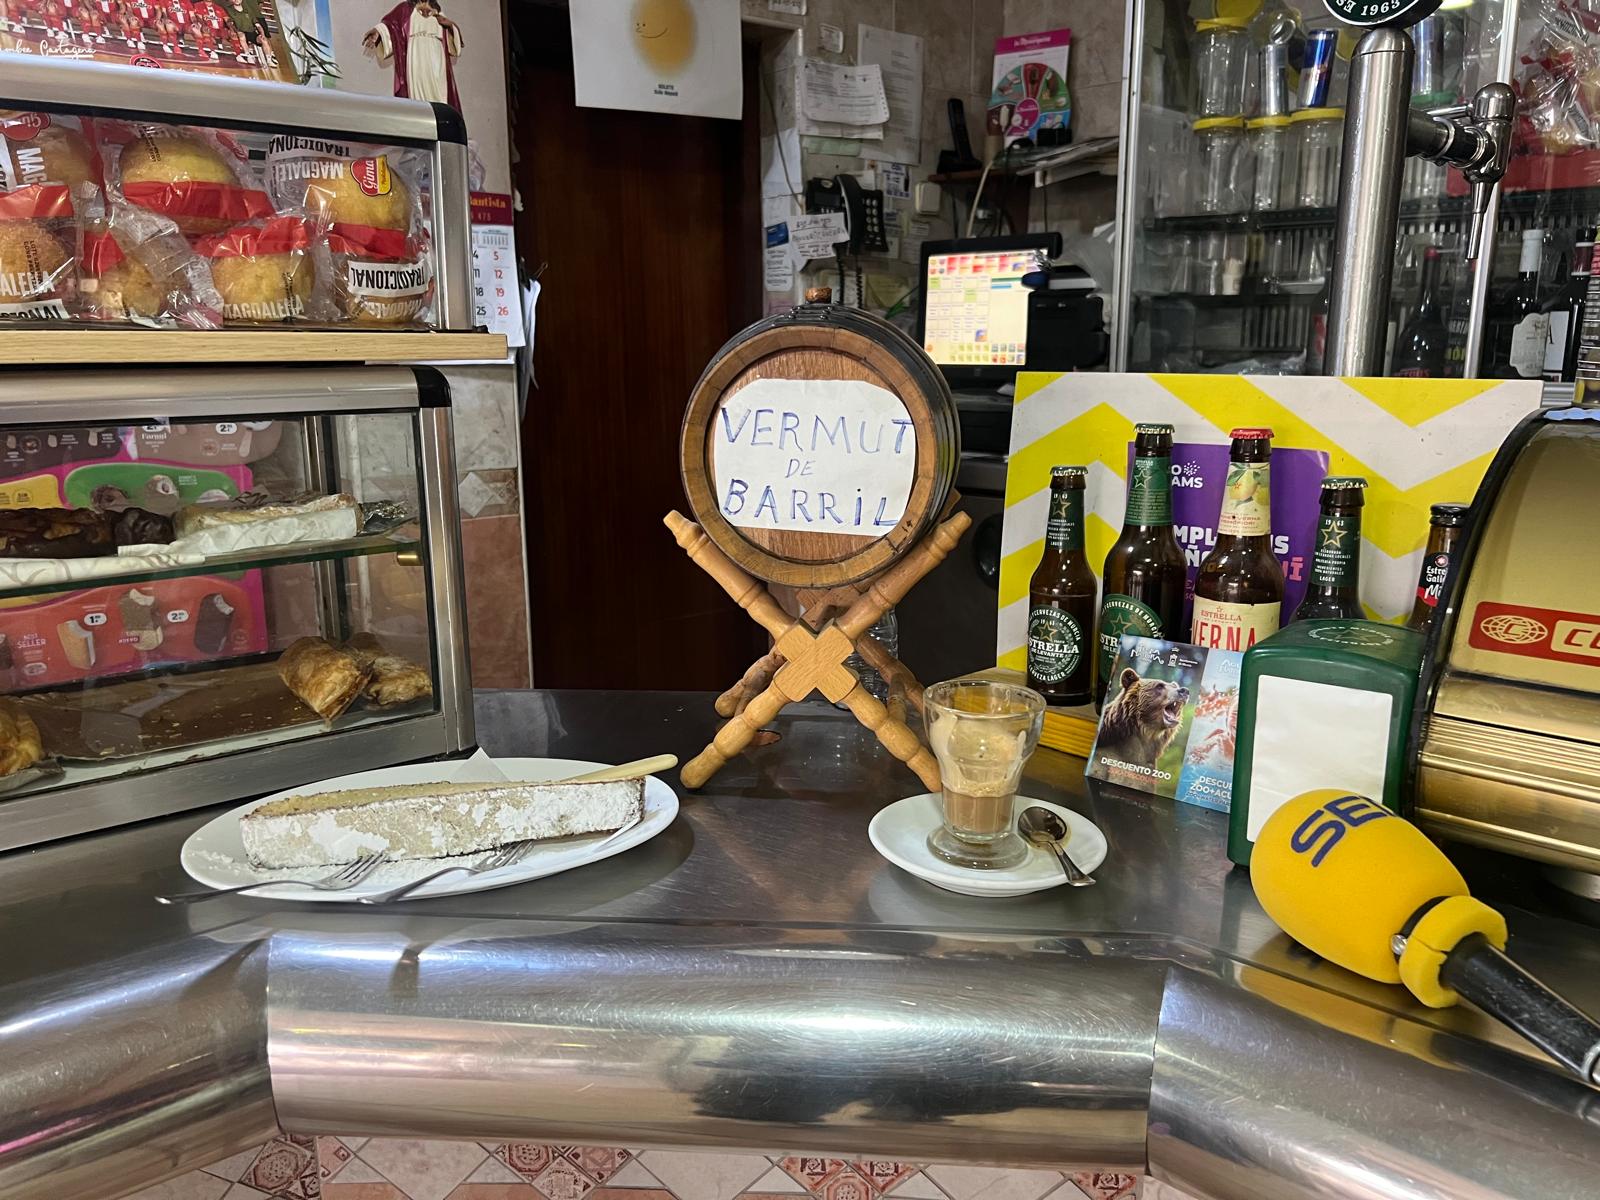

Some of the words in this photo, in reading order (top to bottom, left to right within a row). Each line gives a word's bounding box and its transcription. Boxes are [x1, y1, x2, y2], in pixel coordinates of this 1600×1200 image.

[1360, 0, 1400, 16] 1963
[493, 251, 500, 261] 5
[494, 269, 503, 279] 12
[475, 286, 484, 297] 18
[495, 287, 505, 297] 19
[476, 306, 487, 316] 25
[497, 306, 509, 316] 26
[720, 407, 913, 455] VERMUT
[784, 458, 816, 479] DE
[1171, 476, 1204, 489] AMS
[1134, 607, 1144, 616] DE
[1200, 609, 1242, 622] ESTRELLA
[1060, 614, 1069, 623] DE
[1067, 619, 1081, 641] MURCIA
[1037, 649, 1065, 658] LEVANTE
[1047, 671, 1066, 682] LAGER
[1101, 757, 1152, 776] DESCUENTO
[1152, 769, 1172, 781] ZOO
[1291, 795, 1395, 868] SE
